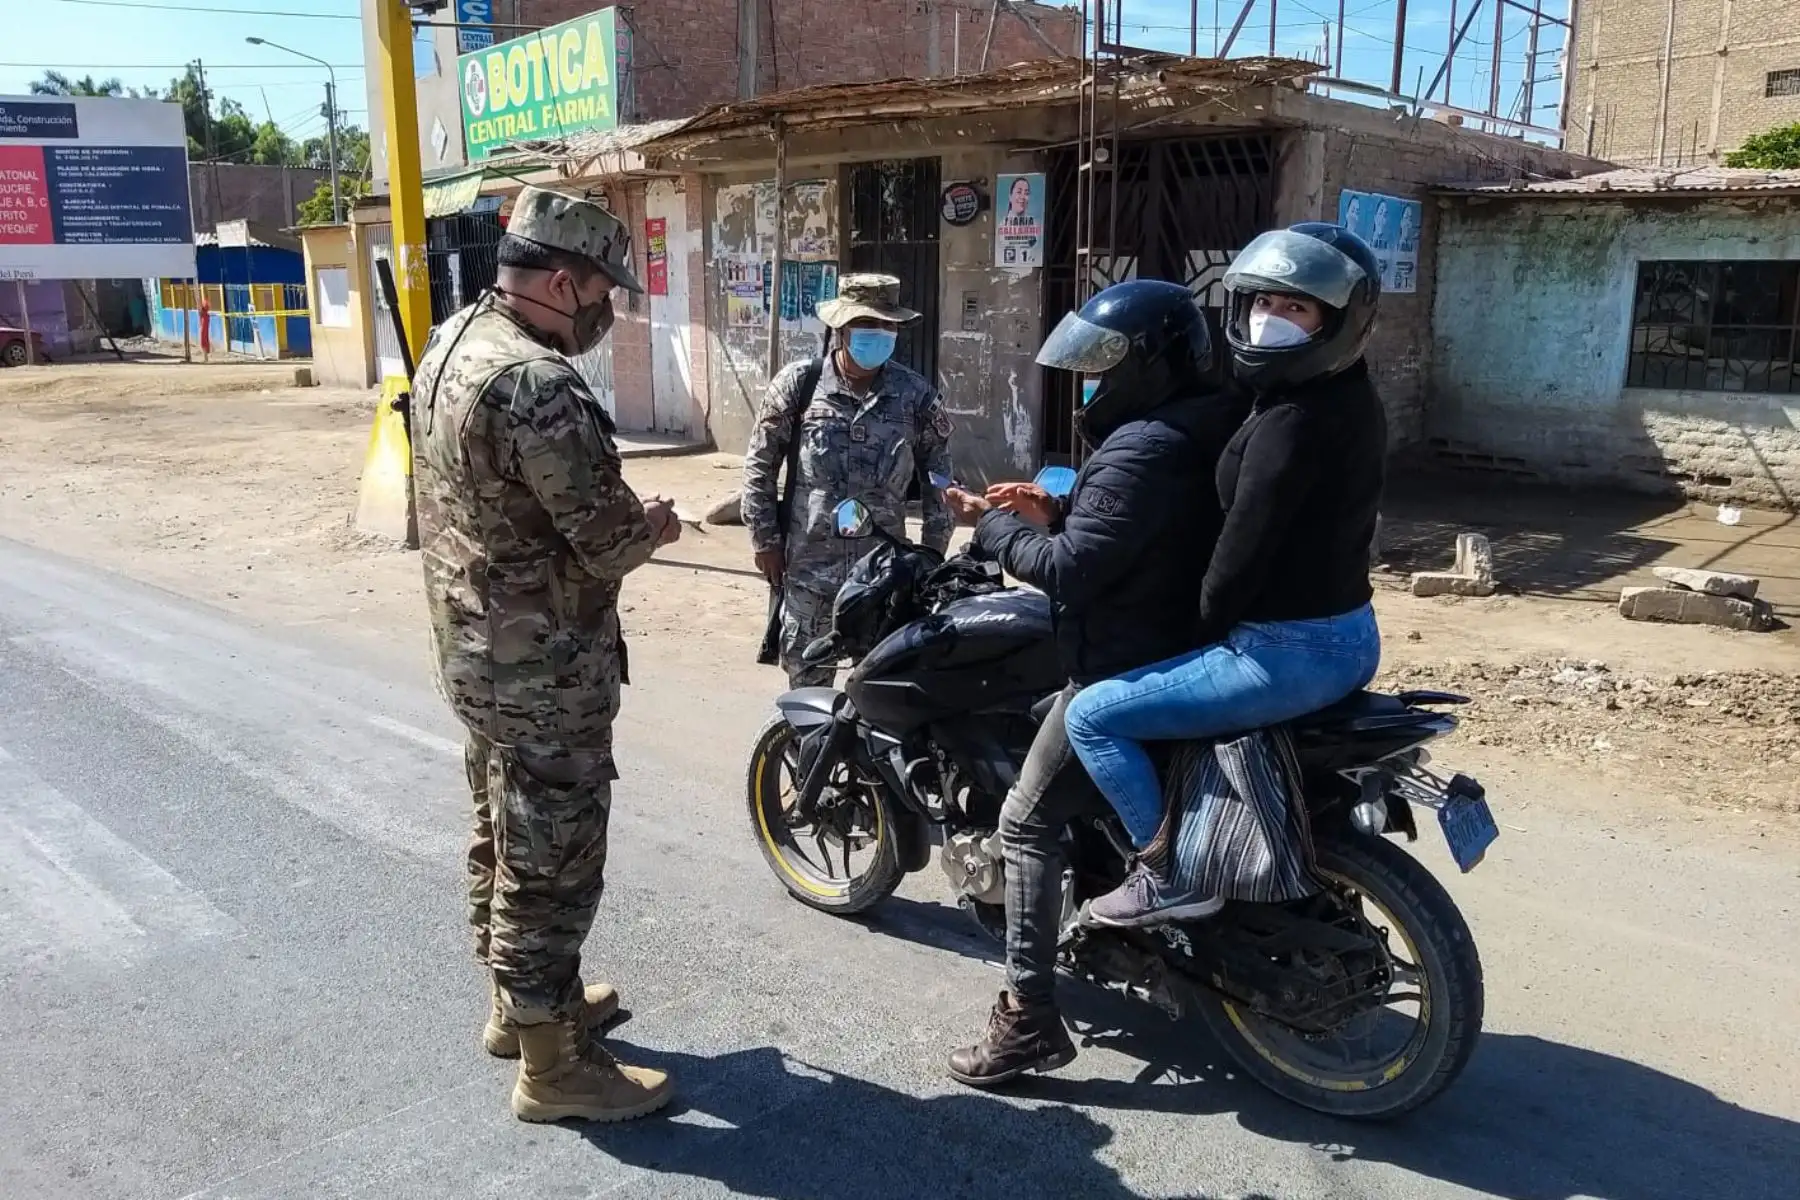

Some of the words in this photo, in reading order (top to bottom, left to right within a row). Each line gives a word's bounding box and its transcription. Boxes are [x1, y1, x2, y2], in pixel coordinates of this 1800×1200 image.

[486, 20, 609, 113] BOTICA
[16, 113, 73, 125] Construcción
[469, 109, 537, 145] CENTRAL
[542, 94, 610, 129] FARMA
